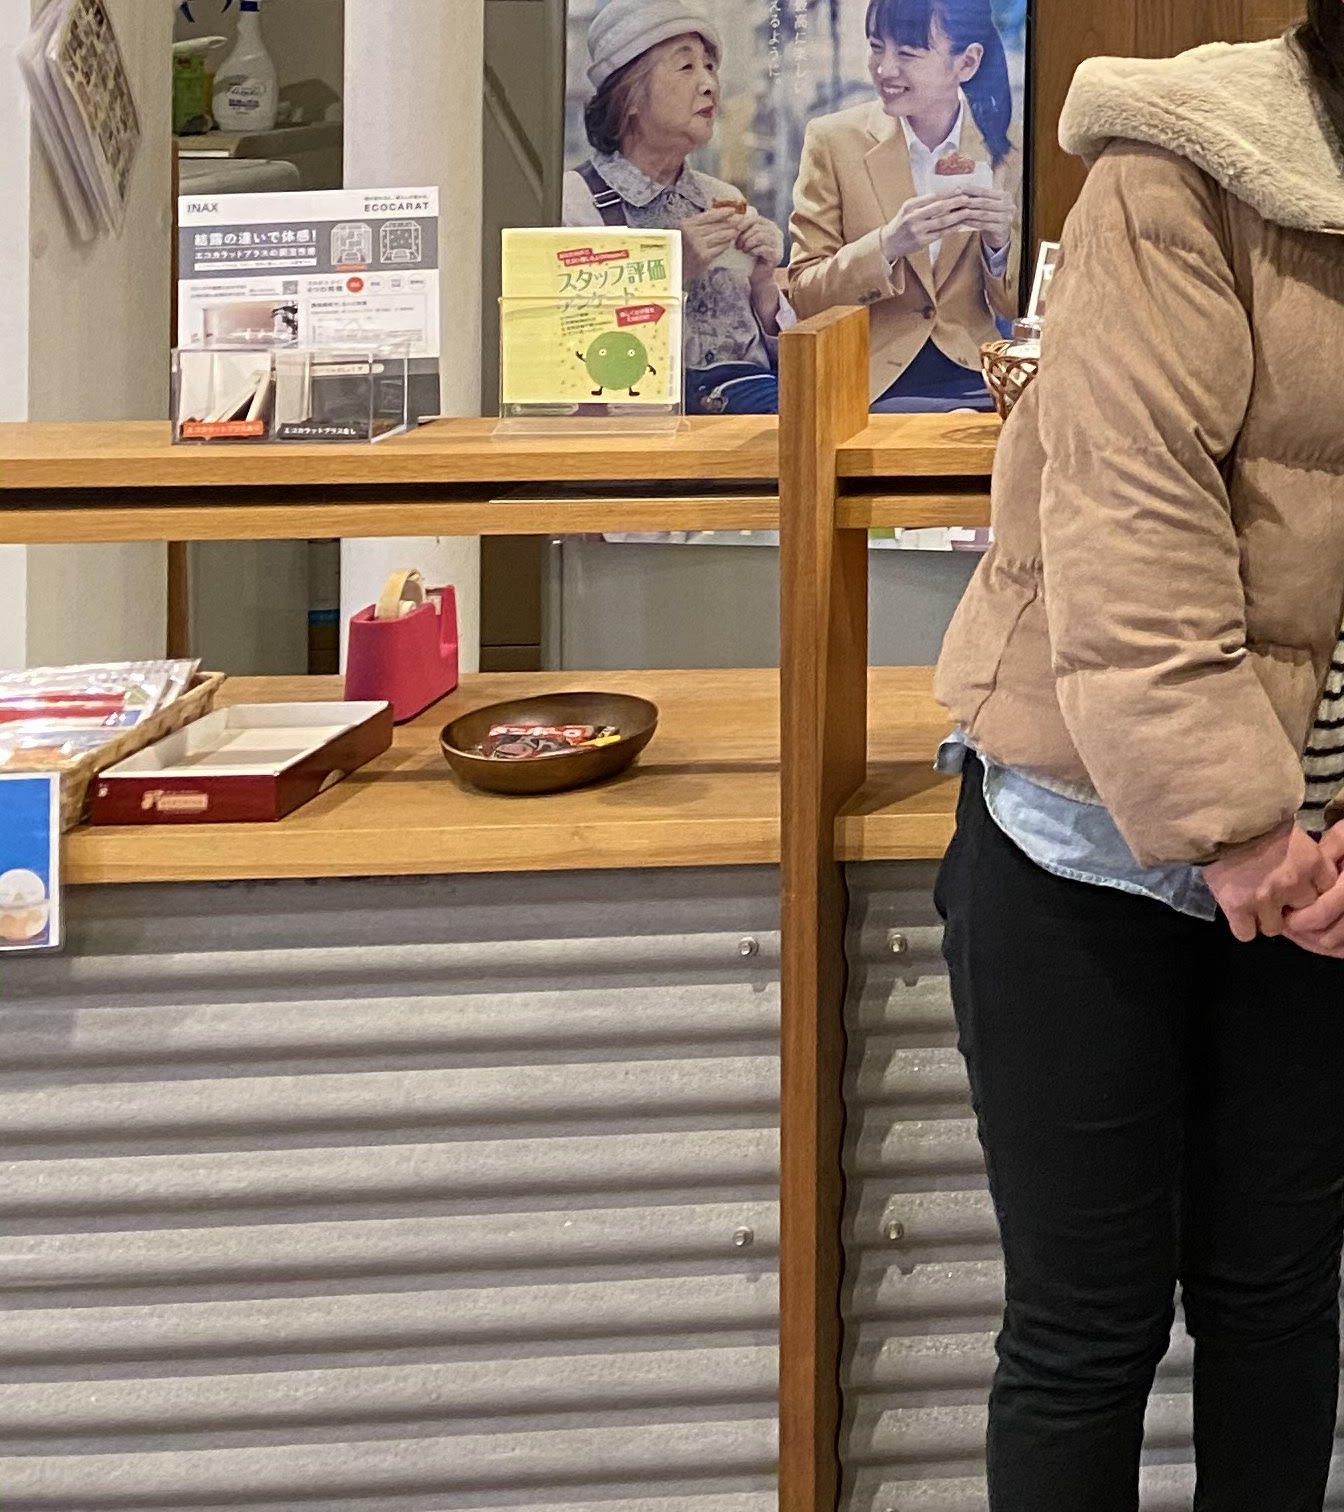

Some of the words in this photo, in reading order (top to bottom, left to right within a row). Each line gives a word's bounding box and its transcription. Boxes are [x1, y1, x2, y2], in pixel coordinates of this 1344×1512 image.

[187, 202, 218, 214] INAX
[364, 201, 430, 213] ECOCARAT
[557, 258, 667, 293] スタッフ評価
